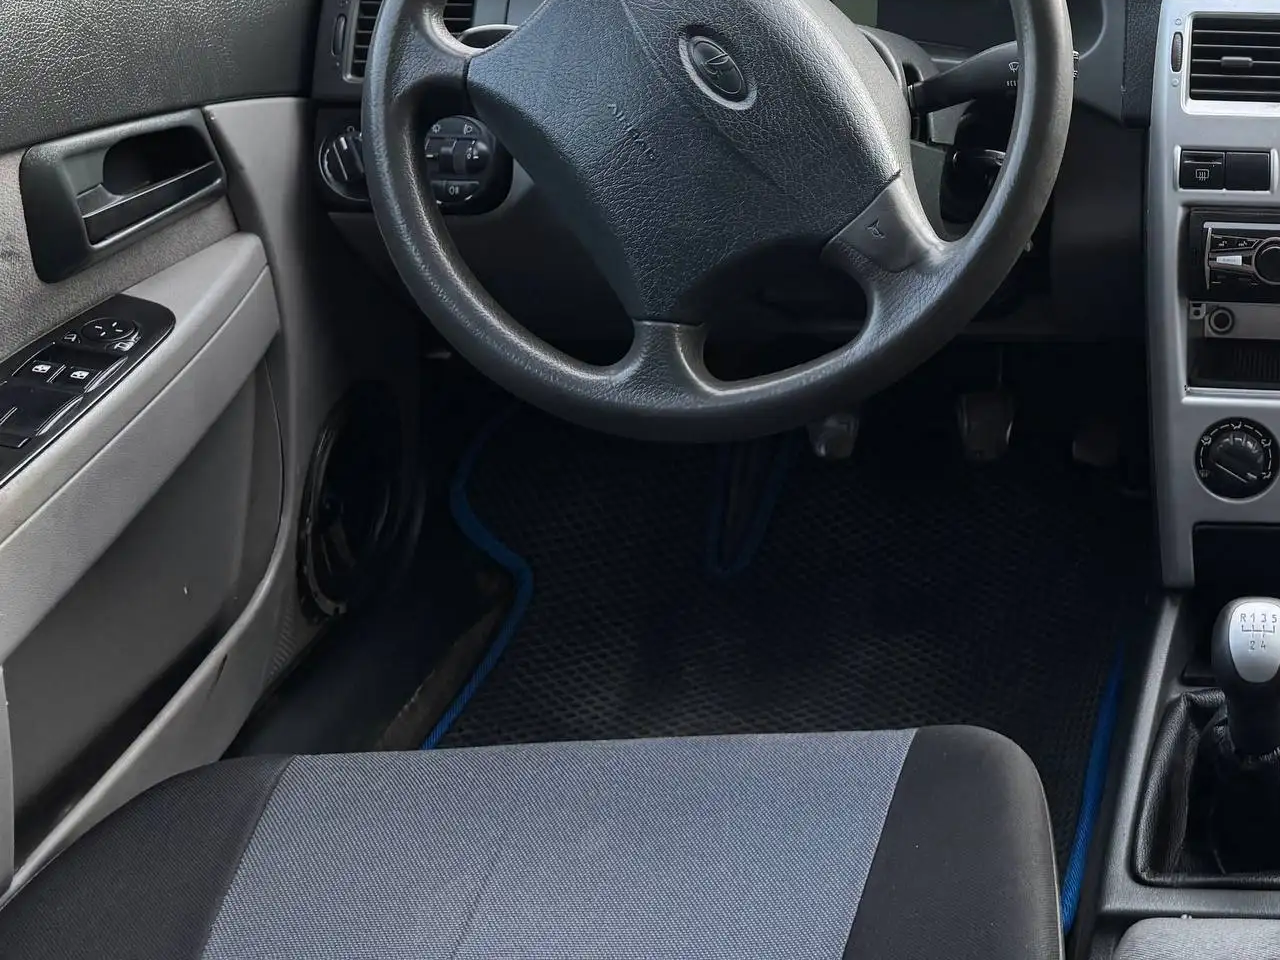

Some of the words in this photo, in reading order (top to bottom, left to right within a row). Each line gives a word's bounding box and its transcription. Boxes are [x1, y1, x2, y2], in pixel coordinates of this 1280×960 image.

[1240, 613, 1246, 622] R
[1261, 613, 1267, 623] 3
[1272, 614, 1277, 623] 5
